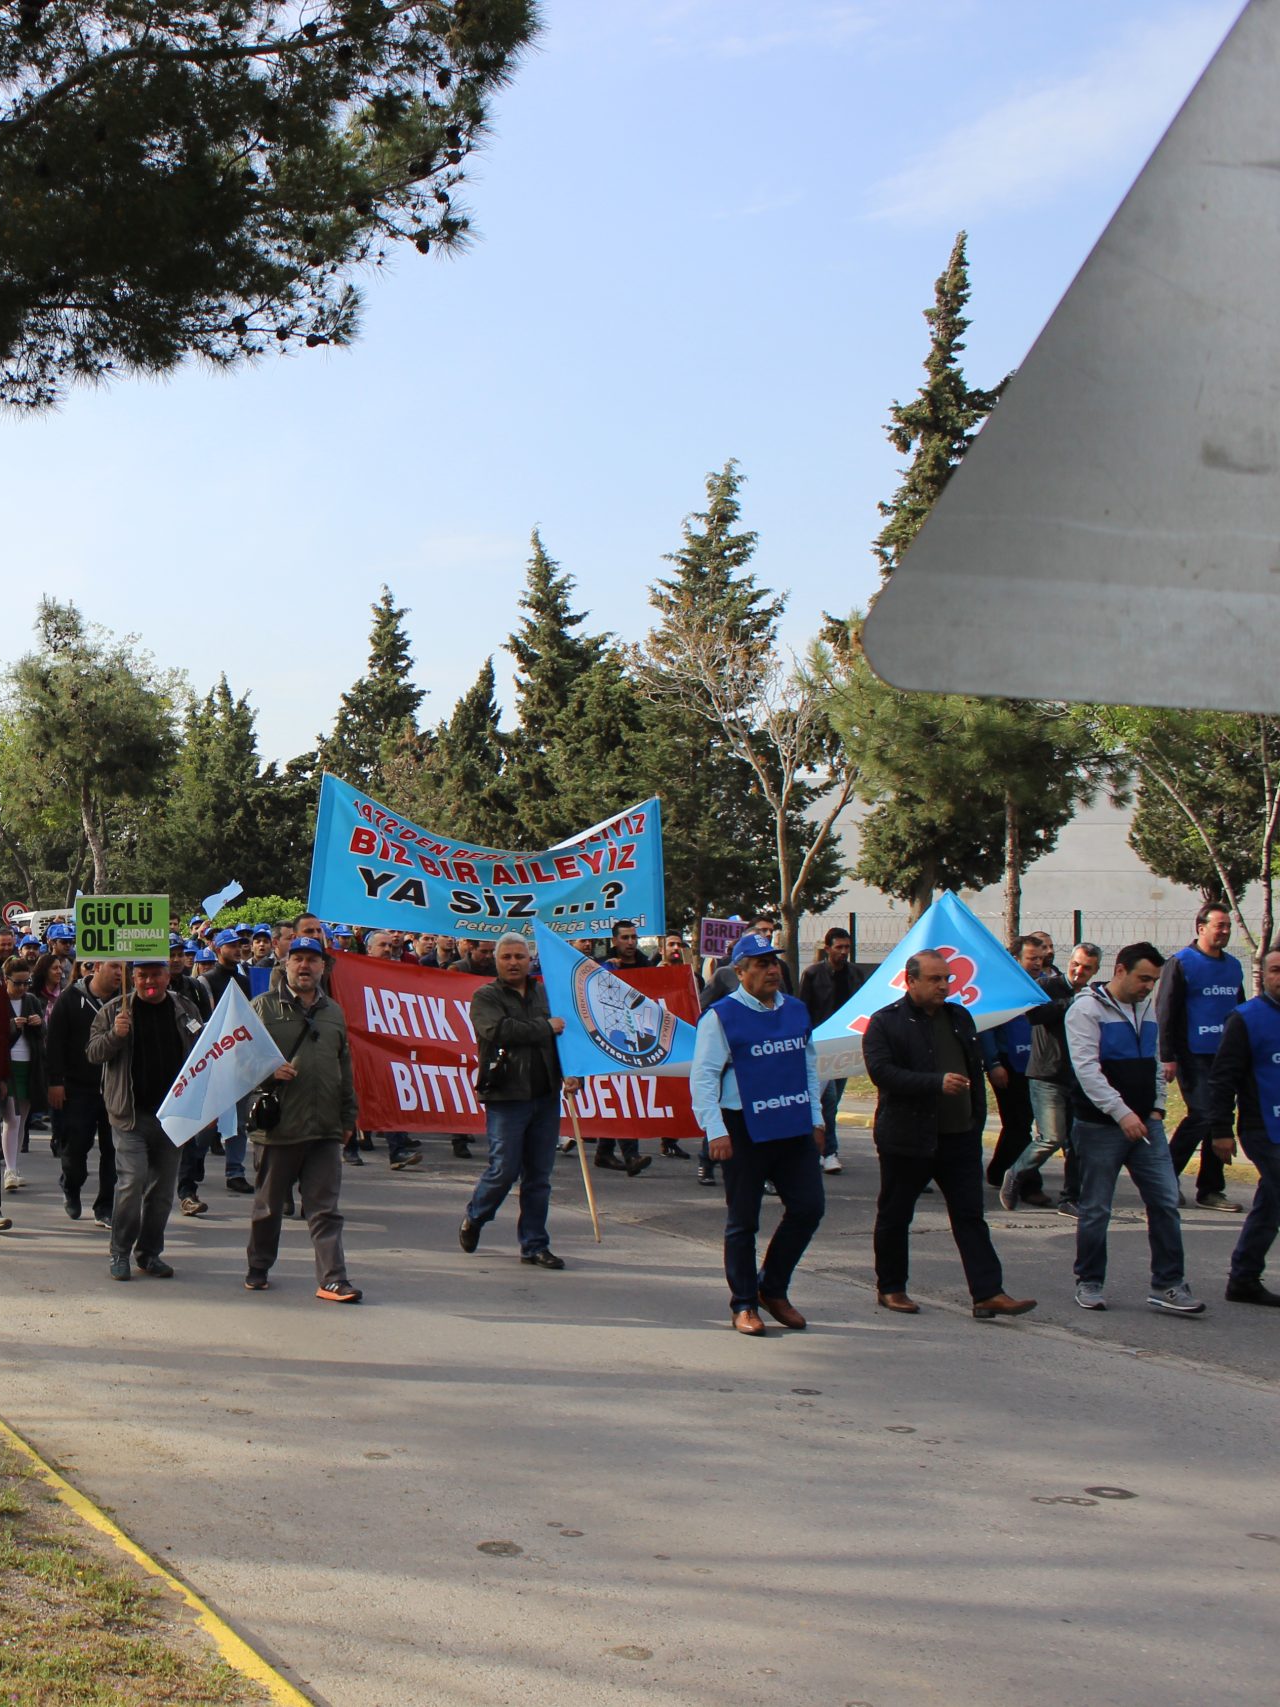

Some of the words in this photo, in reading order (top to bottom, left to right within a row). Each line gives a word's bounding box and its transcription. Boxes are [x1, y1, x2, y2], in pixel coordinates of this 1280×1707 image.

[349, 826, 415, 867] BİZ
[417, 853, 482, 886] BİR
[492, 841, 637, 887] AİLEYİZ
[356, 865, 429, 908] YA
[448, 887, 538, 919] SİZ
[81, 902, 153, 928] GÜÇLÜ
[455, 919, 508, 934] Petrol
[590, 914, 646, 932] şubsi
[81, 929, 115, 952] OL!
[117, 928, 165, 939] SENDİKALI
[117, 941, 132, 952] OL!
[1203, 985, 1239, 996] GÖREV
[364, 986, 459, 1042] ARTIK
[750, 1035, 807, 1057] GÖREVL
[390, 1051, 486, 1115] BİTTİ
